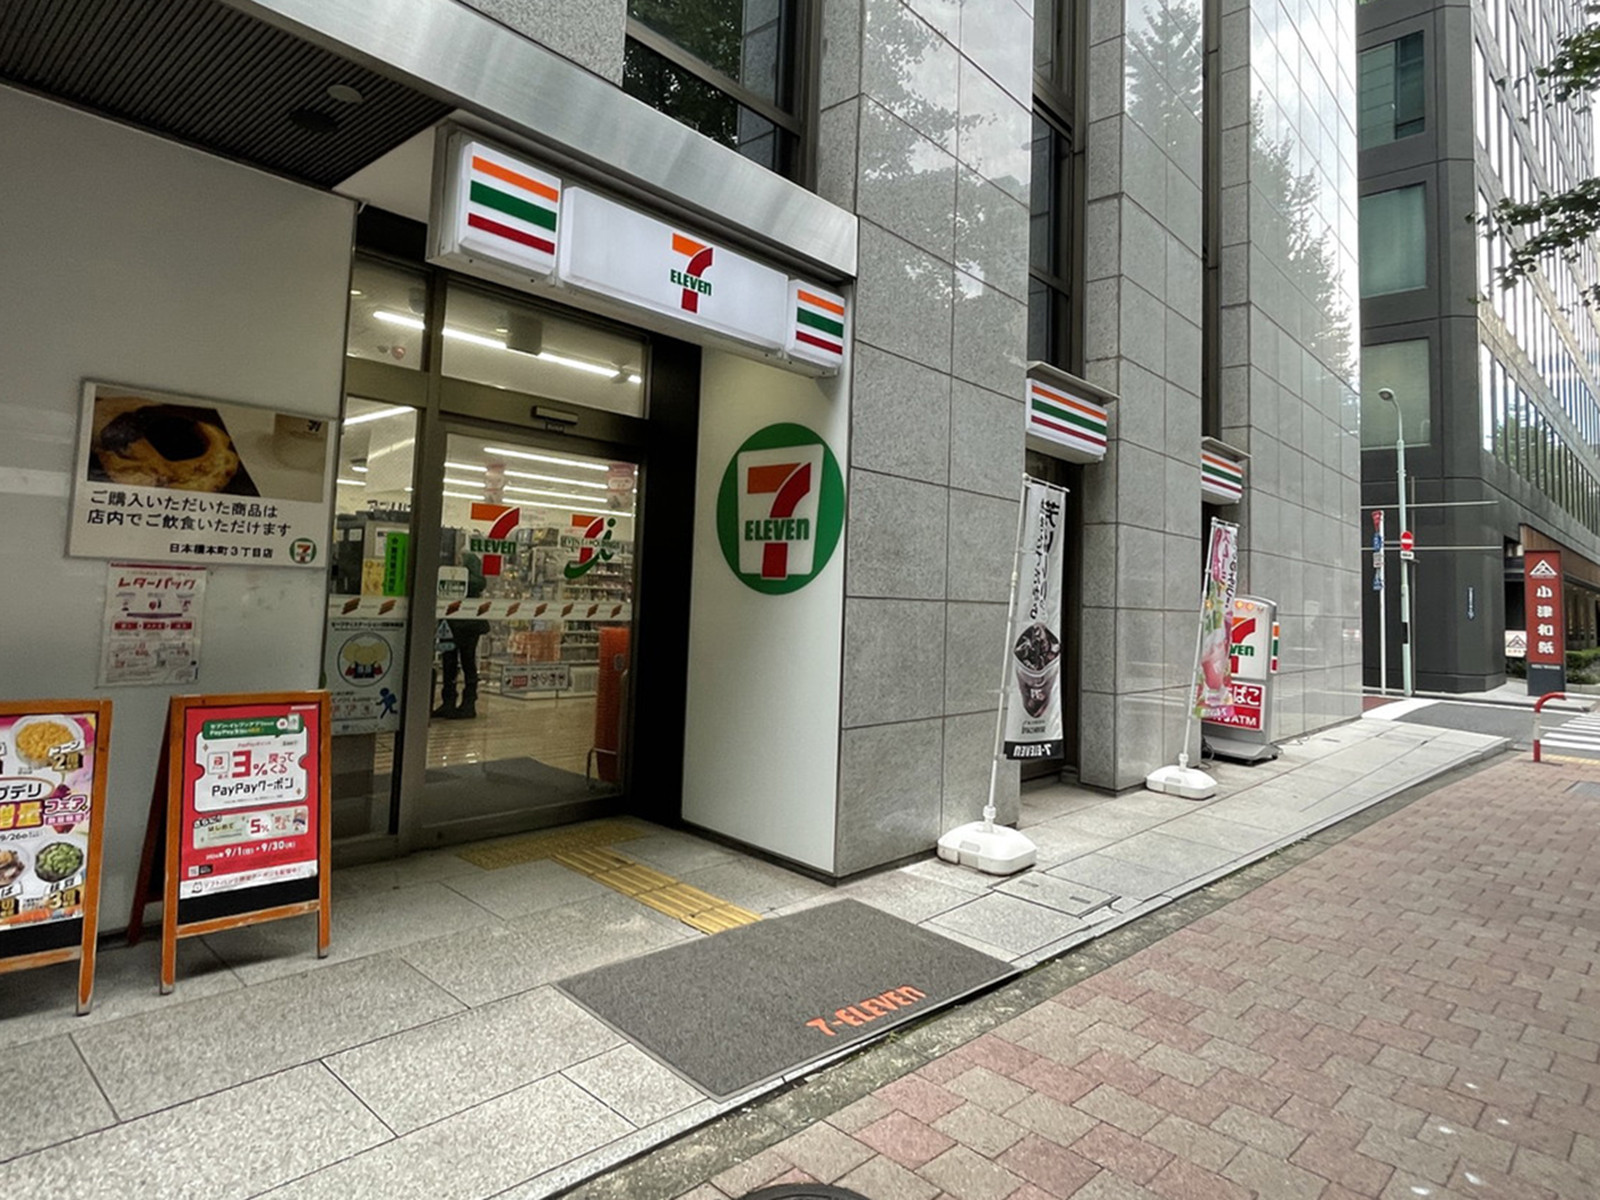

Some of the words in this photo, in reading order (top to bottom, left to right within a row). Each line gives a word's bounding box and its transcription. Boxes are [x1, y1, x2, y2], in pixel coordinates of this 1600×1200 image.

[672, 232, 713, 313] 7
[90, 490, 278, 519] ご購入いただいた商品は
[86, 508, 292, 537] 店内でご飲食いただけます
[747, 462, 812, 578] 7
[470, 502, 520, 576] 7
[232, 750, 268, 778] 3%
[212, 777, 294, 797] PayPayクーポン
[47, 796, 84, 814] フェア
